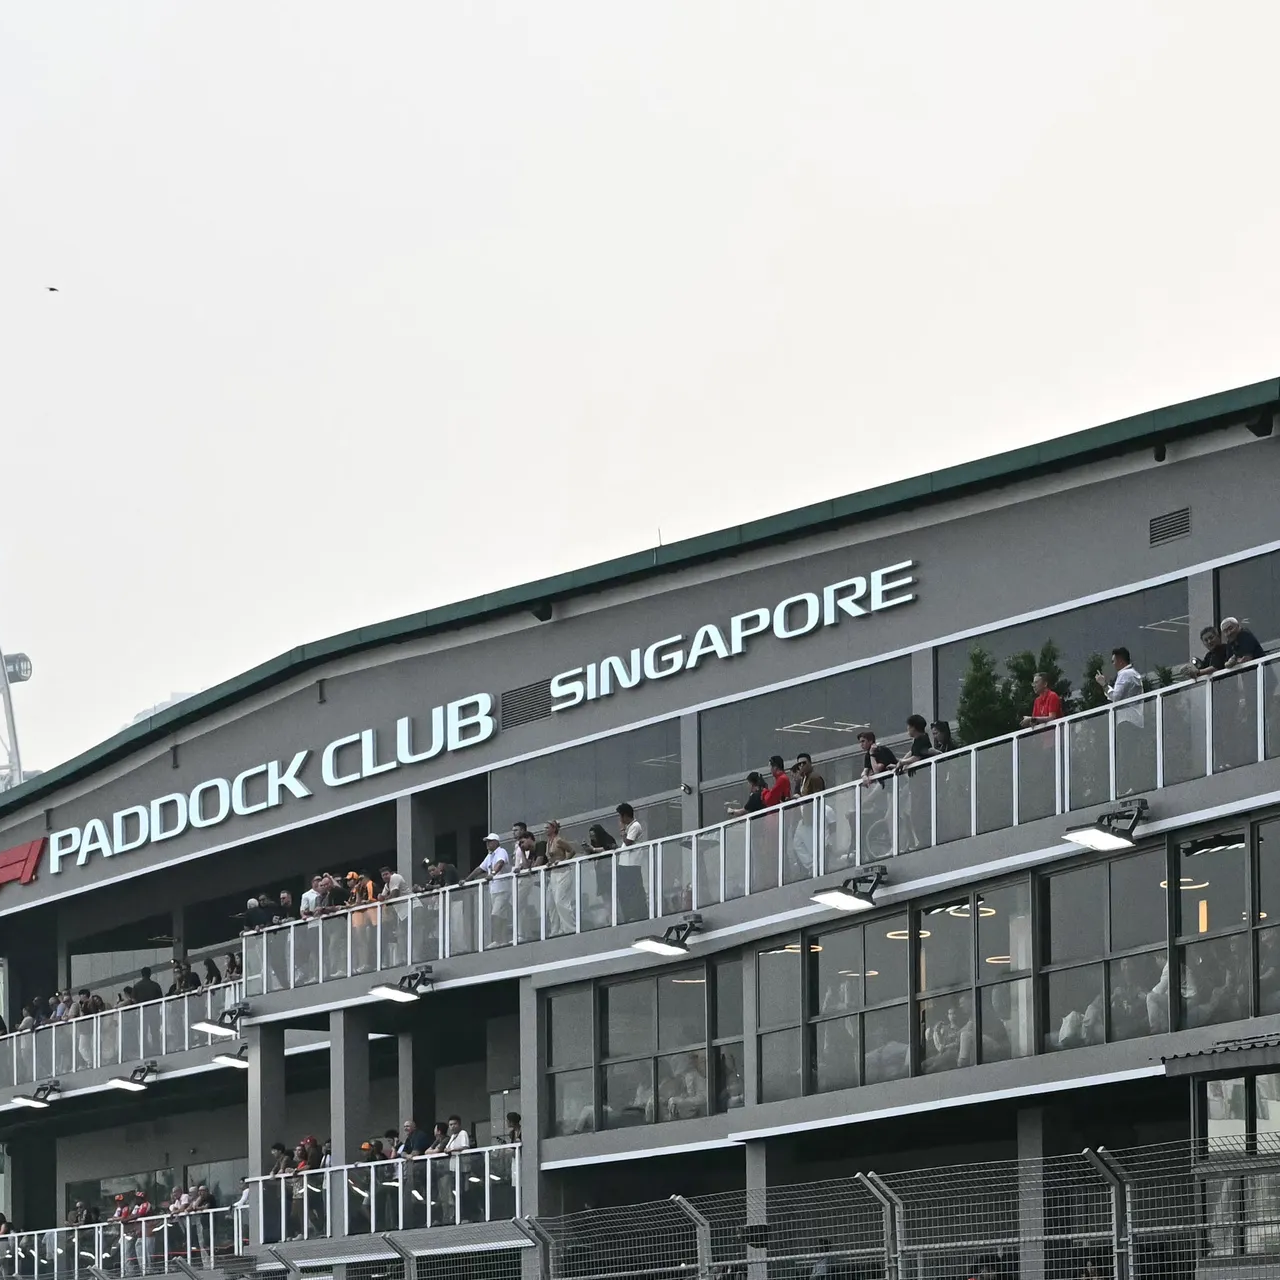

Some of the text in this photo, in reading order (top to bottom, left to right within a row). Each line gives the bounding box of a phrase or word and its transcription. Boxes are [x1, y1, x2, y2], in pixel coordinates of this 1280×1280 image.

[48, 749, 312, 876] PADDOCK
[322, 692, 495, 788] CLUB
[550, 559, 918, 713] SINGAPORE
